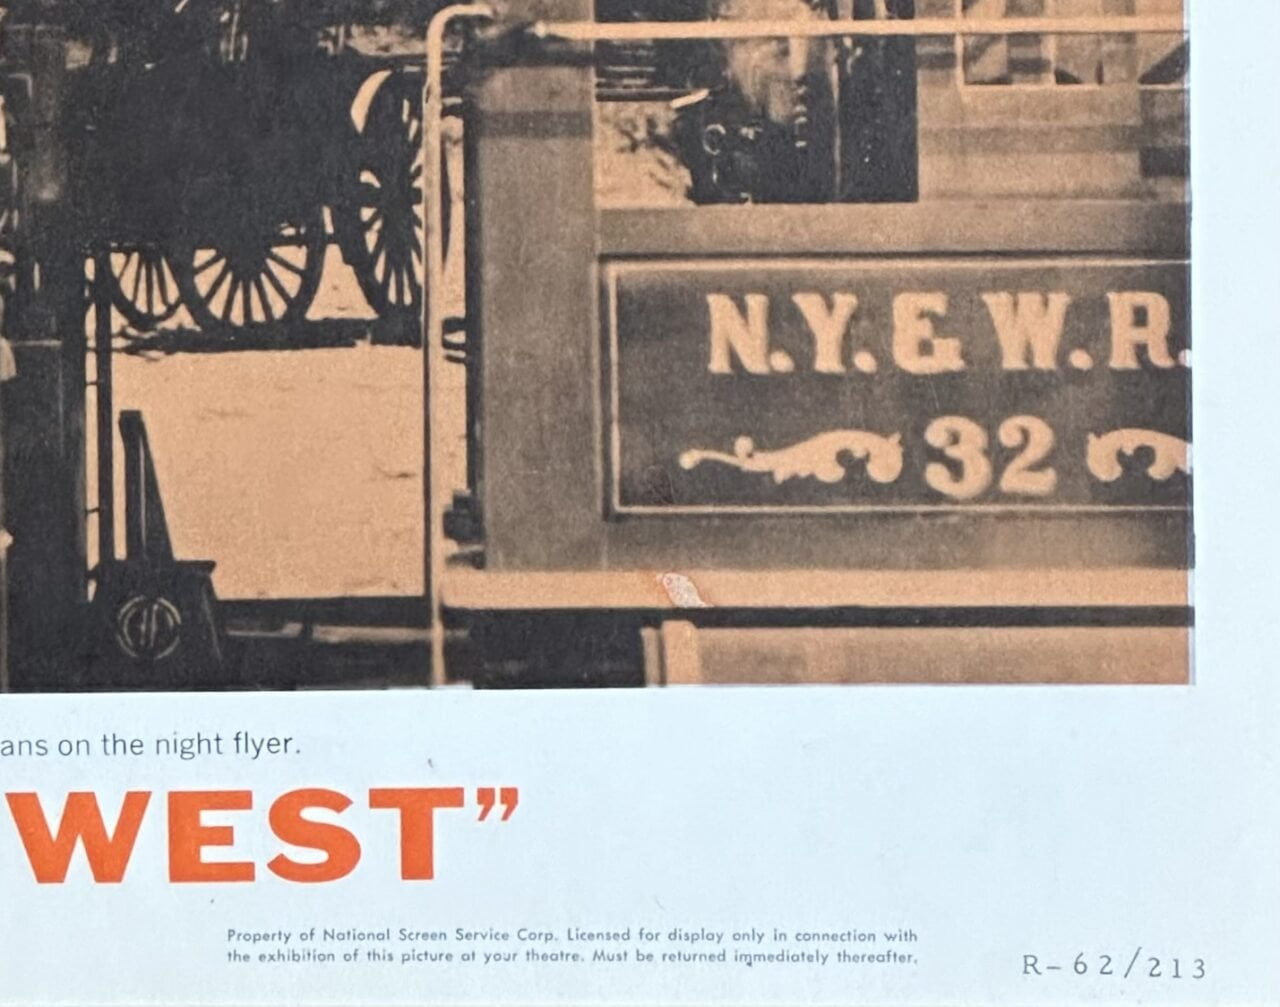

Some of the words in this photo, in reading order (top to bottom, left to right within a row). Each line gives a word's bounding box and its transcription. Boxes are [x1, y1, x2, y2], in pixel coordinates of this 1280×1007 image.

[924, 415, 1058, 499] 32
[58, 740, 89, 756] on
[102, 733, 143, 756] the
[156, 732, 223, 760] night
[233, 731, 300, 760] flyer.
[228, 929, 291, 945] Property
[300, 928, 315, 941] of
[323, 928, 390, 941] National
[399, 928, 447, 941] Screen
[456, 928, 509, 941] Service
[517, 928, 558, 944] Corp.
[568, 928, 630, 941] Licensed
[639, 928, 660, 941] for
[668, 928, 723, 945] display
[732, 928, 764, 945] only
[774, 928, 787, 941] in
[795, 929, 876, 942] connection
[884, 929, 917, 942] with
[227, 949, 250, 962] the
[259, 949, 335, 962] exhibition
[343, 948, 359, 962] of
[367, 949, 393, 961] this
[402, 949, 453, 964] picture
[461, 950, 475, 961] at
[484, 952, 517, 964] your
[526, 948, 584, 962] theatre.
[593, 950, 627, 962] Must
[636, 949, 654, 962] be
[662, 949, 726, 962] returned
[735, 949, 828, 965] immediately
[837, 950, 917, 964] thereafter.
